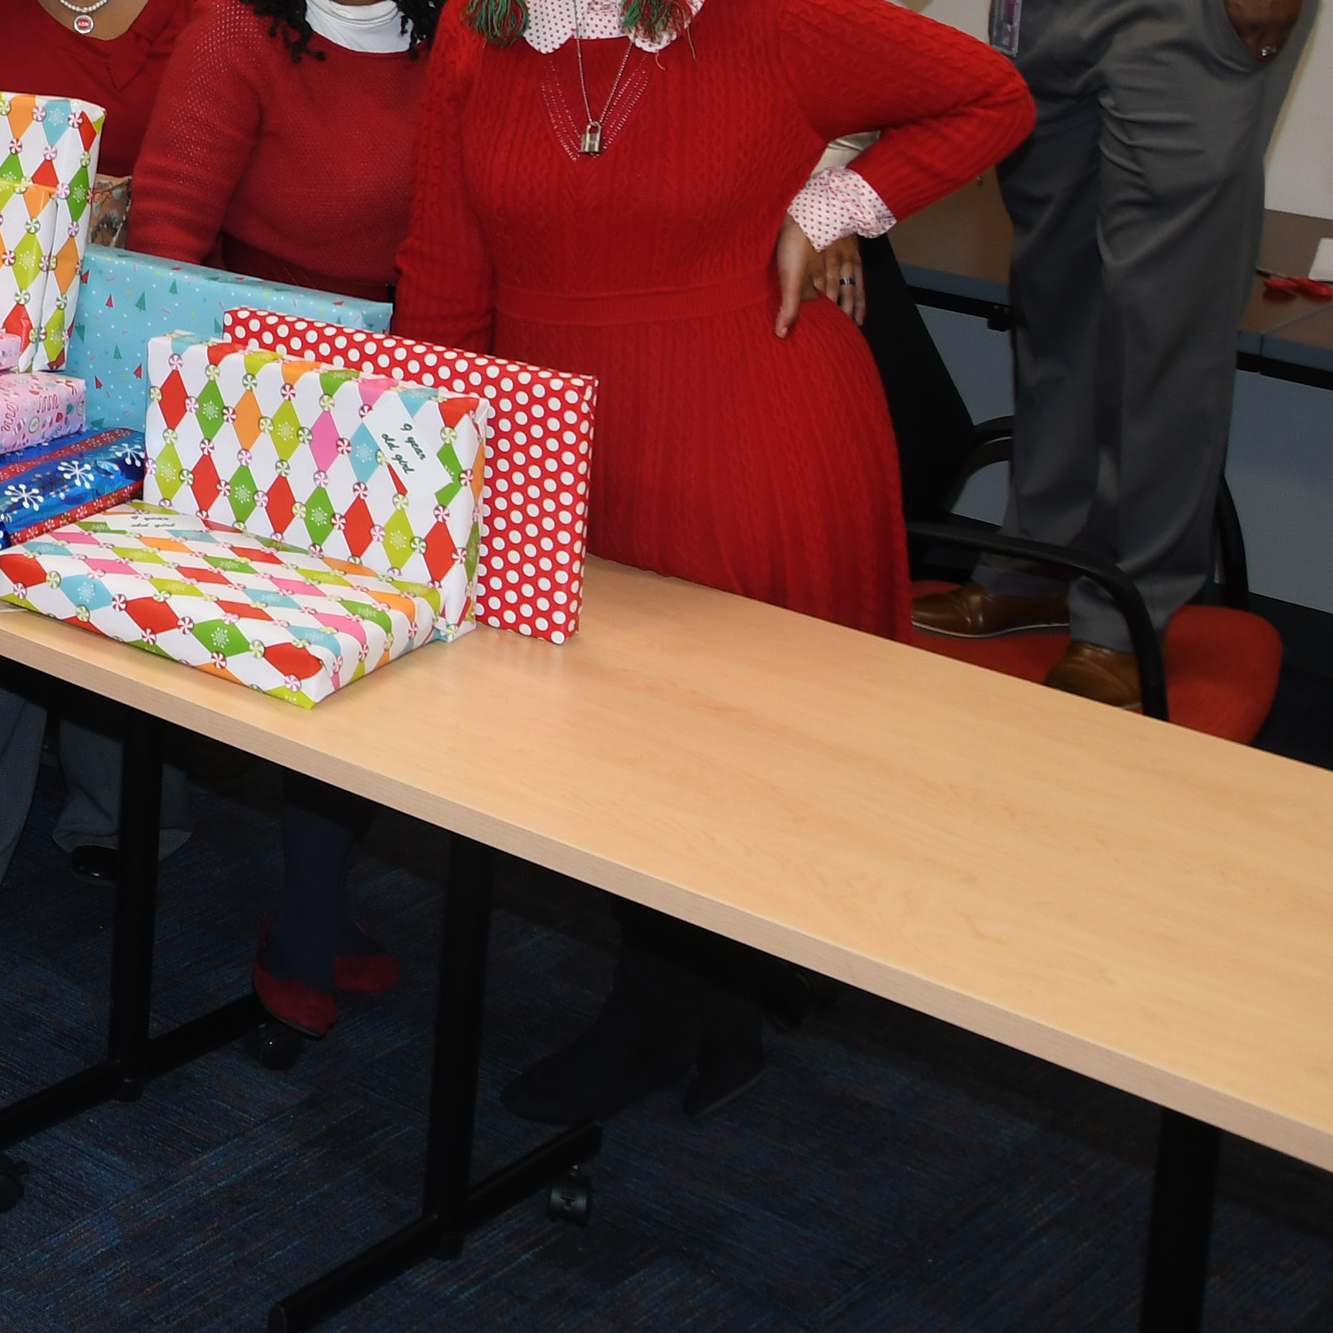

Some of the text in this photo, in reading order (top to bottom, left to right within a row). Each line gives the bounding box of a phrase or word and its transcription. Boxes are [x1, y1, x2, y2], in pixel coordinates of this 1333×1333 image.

[381, 433, 415, 474] old girl
[400, 422, 426, 461] 9 year
